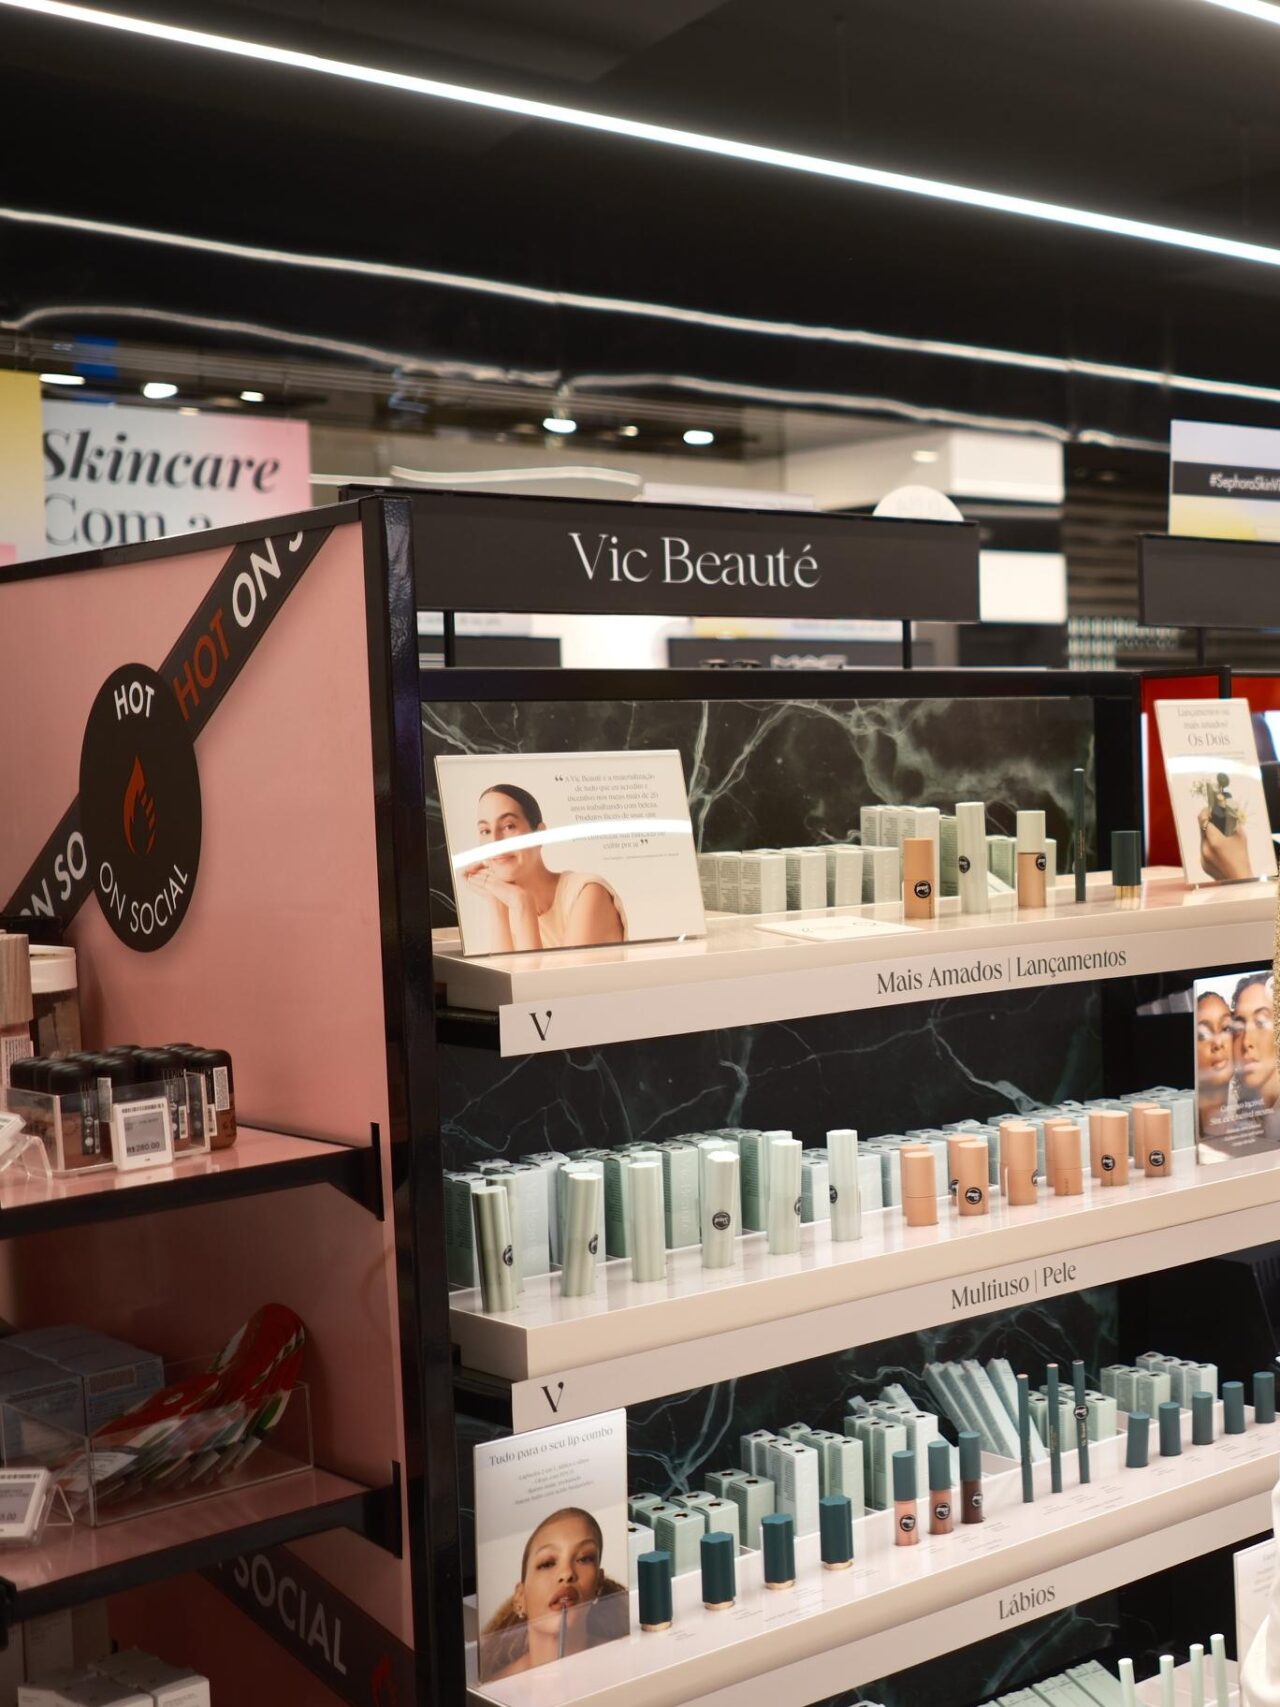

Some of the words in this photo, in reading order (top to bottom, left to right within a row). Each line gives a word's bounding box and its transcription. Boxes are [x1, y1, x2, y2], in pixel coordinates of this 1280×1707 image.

[44, 429, 281, 493] Skincare
[232, 537, 281, 628] ON
[568, 532, 650, 582] Vic
[661, 535, 822, 589] Beauté
[173, 608, 231, 720] HOT
[113, 681, 155, 720] HOT
[1188, 734, 1204, 747] Os
[1206, 733, 1231, 747] Dois
[100, 861, 126, 921] ON
[130, 864, 188, 935] SOCIAL
[877, 970, 923, 996] Mais
[928, 961, 1003, 989] Amados
[1016, 949, 1127, 977] Lançamentos
[529, 1010, 552, 1041] V
[951, 1274, 1030, 1310] Multiuso
[1042, 1262, 1077, 1288] Pele
[541, 1382, 564, 1413] V
[489, 1454, 515, 1467] Tudo
[517, 1448, 539, 1461] para
[549, 1440, 566, 1451] seu
[568, 1435, 581, 1448] lip
[581, 1426, 614, 1442] combo
[233, 1553, 347, 1676] SOCIAL
[998, 1584, 1057, 1620] Lábios
